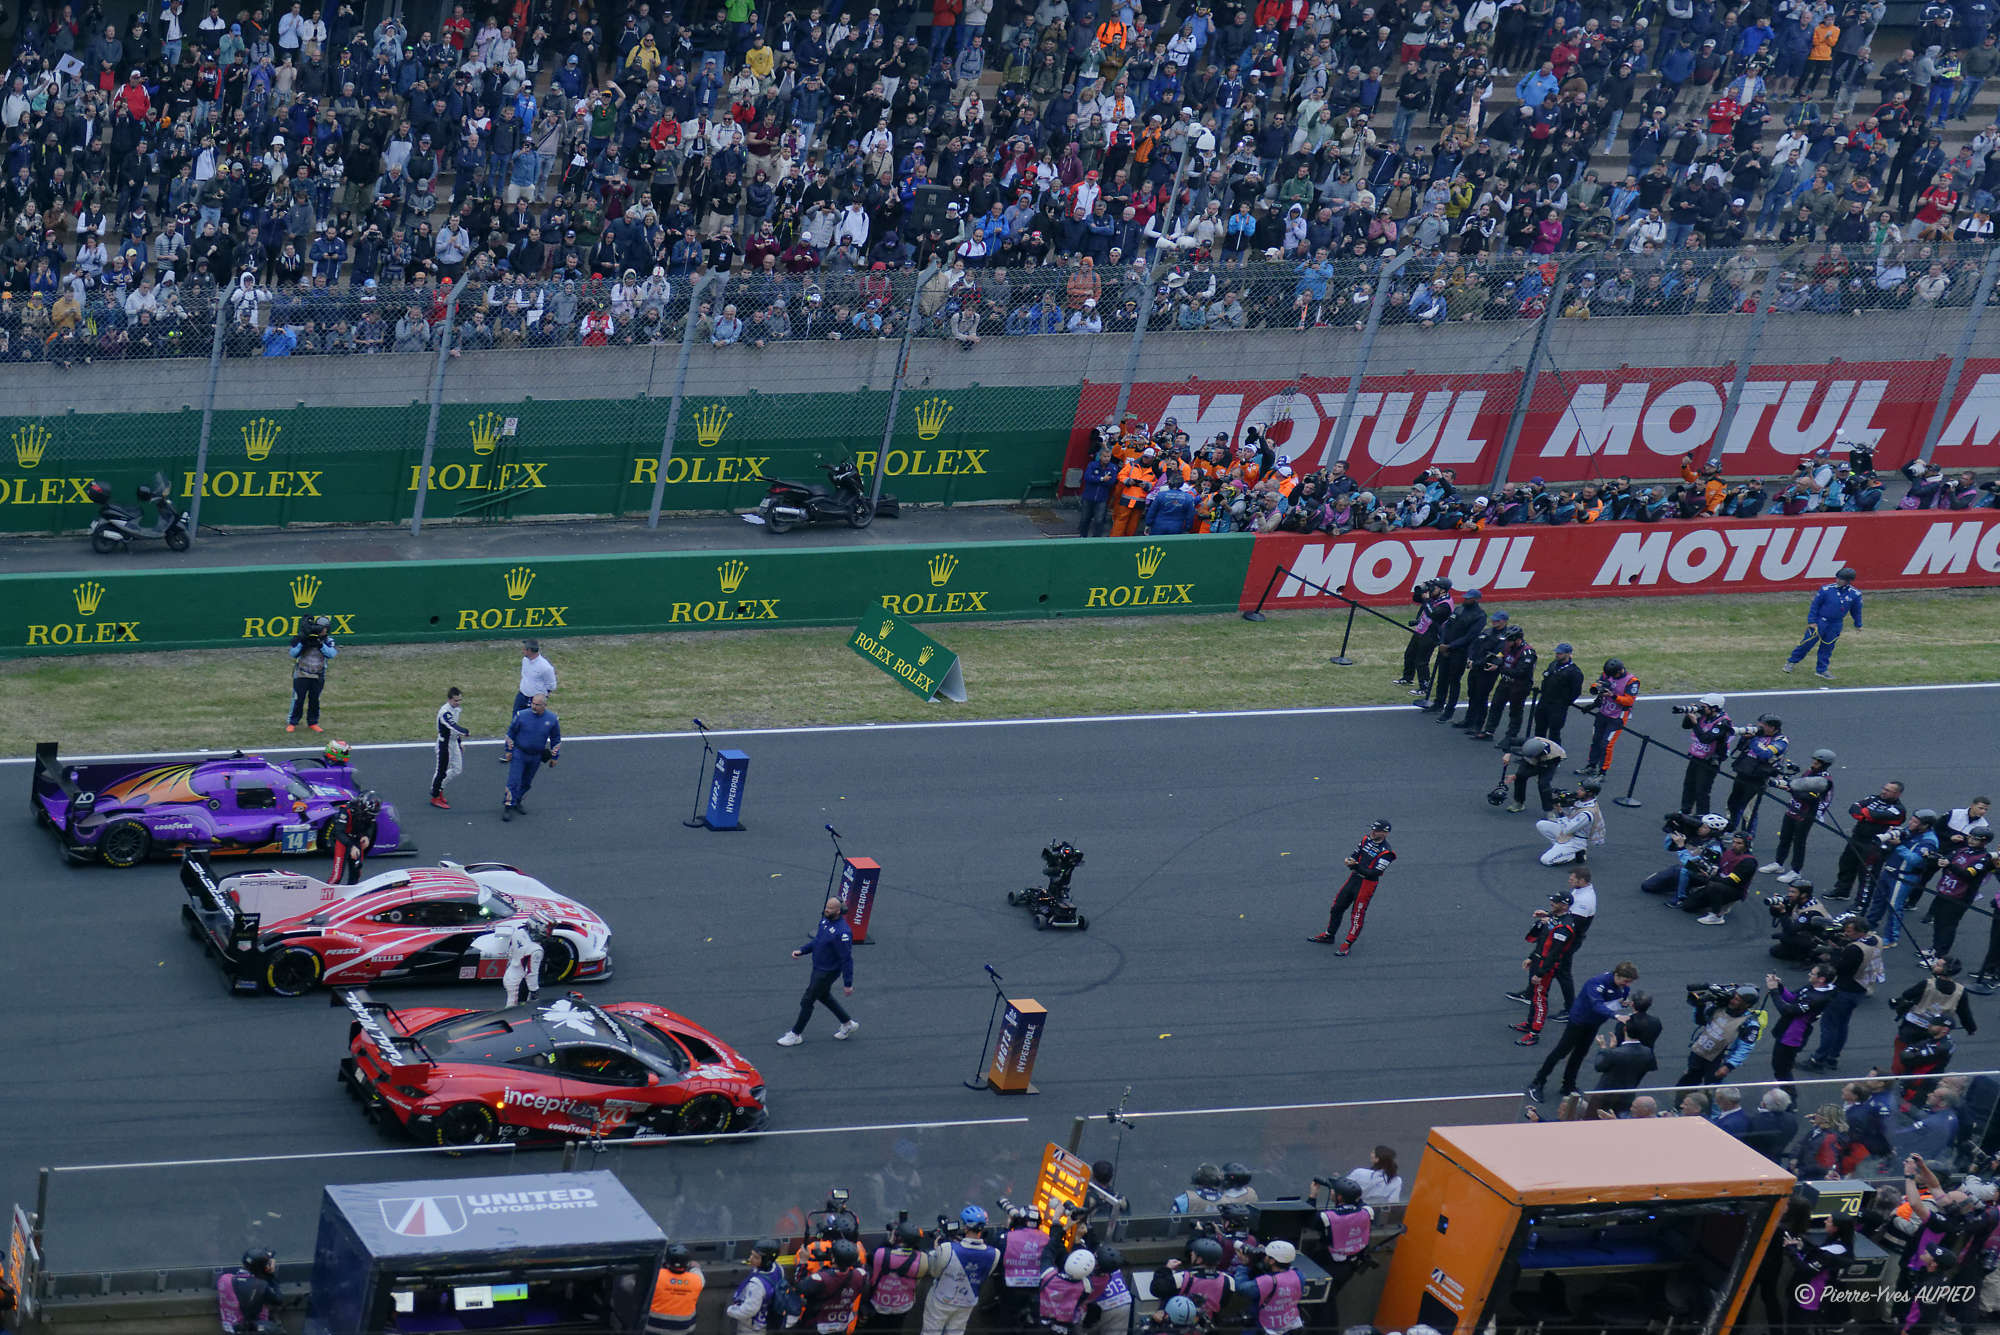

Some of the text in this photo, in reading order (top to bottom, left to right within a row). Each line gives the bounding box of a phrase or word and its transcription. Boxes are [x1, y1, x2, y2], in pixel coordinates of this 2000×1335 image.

[1153, 389, 1488, 467] MOTUL
[1539, 379, 1889, 457] MOTUL
[630, 457, 770, 483] ROLEX
[856, 449, 988, 476] ROLEX
[180, 471, 323, 497] ROLEX
[1276, 536, 1536, 598] MOTUL
[1591, 526, 1847, 586] MOTUL
[882, 592, 989, 614] ROLEX
[1084, 583, 1194, 608] ROLEX
[455, 606, 569, 630] ROLEX
[668, 599, 780, 623] ROLEX
[26, 621, 141, 646] ROLEX
[242, 614, 356, 638] ROLX
[854, 632, 934, 693] ROLEX ROLEX
[725, 769, 741, 813] HYPERPOLE
[287, 833, 304, 849] 14
[854, 878, 871, 925] HYPERPOLE
[486, 959, 499, 976] 6
[1017, 1024, 1036, 1073] HYPERPOLE
[503, 1086, 601, 1118] inception
[600, 1107, 628, 1124] 70
[548, 1123, 590, 1135] GOODYEAR
[466, 1188, 595, 1206] UNITED
[472, 1200, 599, 1215] AUTOSPORTS
[1841, 1198, 1861, 1214] 70
